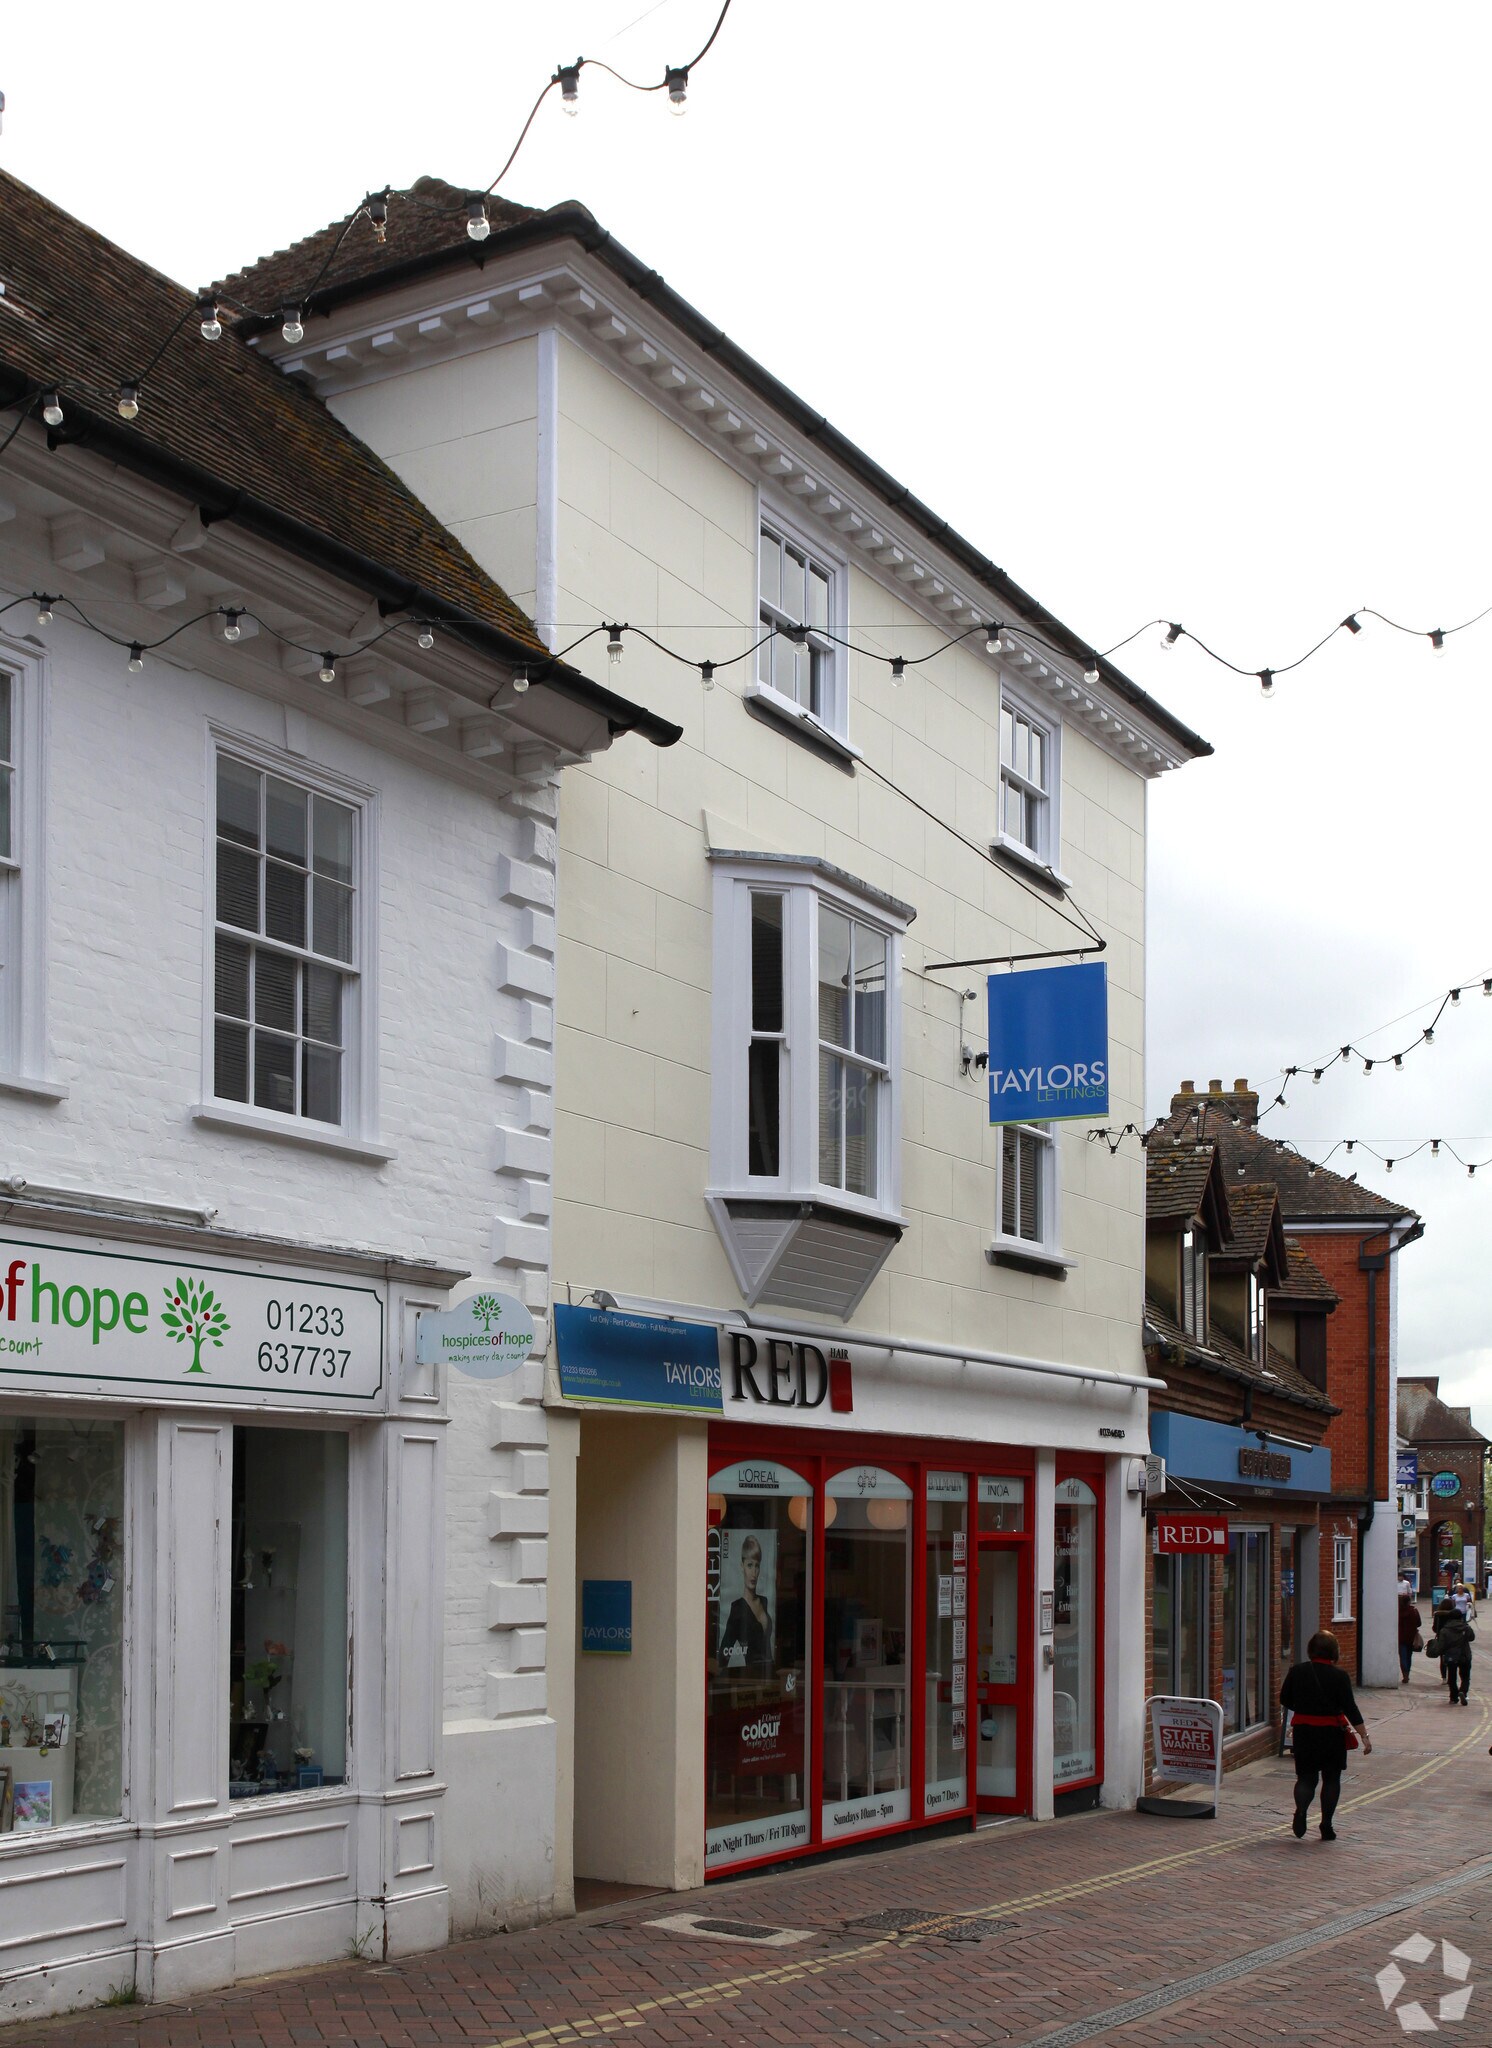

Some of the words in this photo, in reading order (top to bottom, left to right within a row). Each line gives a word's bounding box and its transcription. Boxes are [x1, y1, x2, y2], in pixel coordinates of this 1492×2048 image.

[989, 1061, 1106, 1094] TAYLORS
[1037, 1084, 1106, 1102] LETTINGS
[266, 1300, 345, 1337] 01233
[624, 1319, 646, 1329] Collection
[659, 1325, 687, 1335] Management
[258, 1342, 352, 1378] 637737
[448, 1354, 471, 1363] making
[472, 1354, 489, 1362] every
[491, 1351, 504, 1362] day
[507, 1351, 526, 1360] count
[830, 1348, 849, 1360] HAIR
[663, 1362, 721, 1389] TAYLORS
[728, 1331, 828, 1408] RED
[689, 1386, 723, 1399] LETTINGS
[1163, 1526, 1213, 1544] RED
[708, 1528, 721, 1601] RED
[583, 1626, 632, 1639] TAYLORS
[741, 1719, 781, 1741] colour
[1172, 1718, 1193, 1727] RED
[1163, 1729, 1209, 1743] STAFF
[1163, 1740, 1211, 1752] WANTED
[926, 1792, 941, 1806] Open
[942, 1790, 946, 1802] 7
[946, 1789, 959, 1803] Days
[833, 1811, 860, 1825] Sundays
[860, 1807, 877, 1820] 10am
[880, 1804, 894, 1817] 5pm
[705, 1842, 722, 1856] Late
[722, 1838, 742, 1853] Night
[744, 1833, 765, 1846] Thurs
[769, 1827, 780, 1841] Fri
[781, 1825, 790, 1838] Til
[791, 1823, 806, 1837] 8pm
